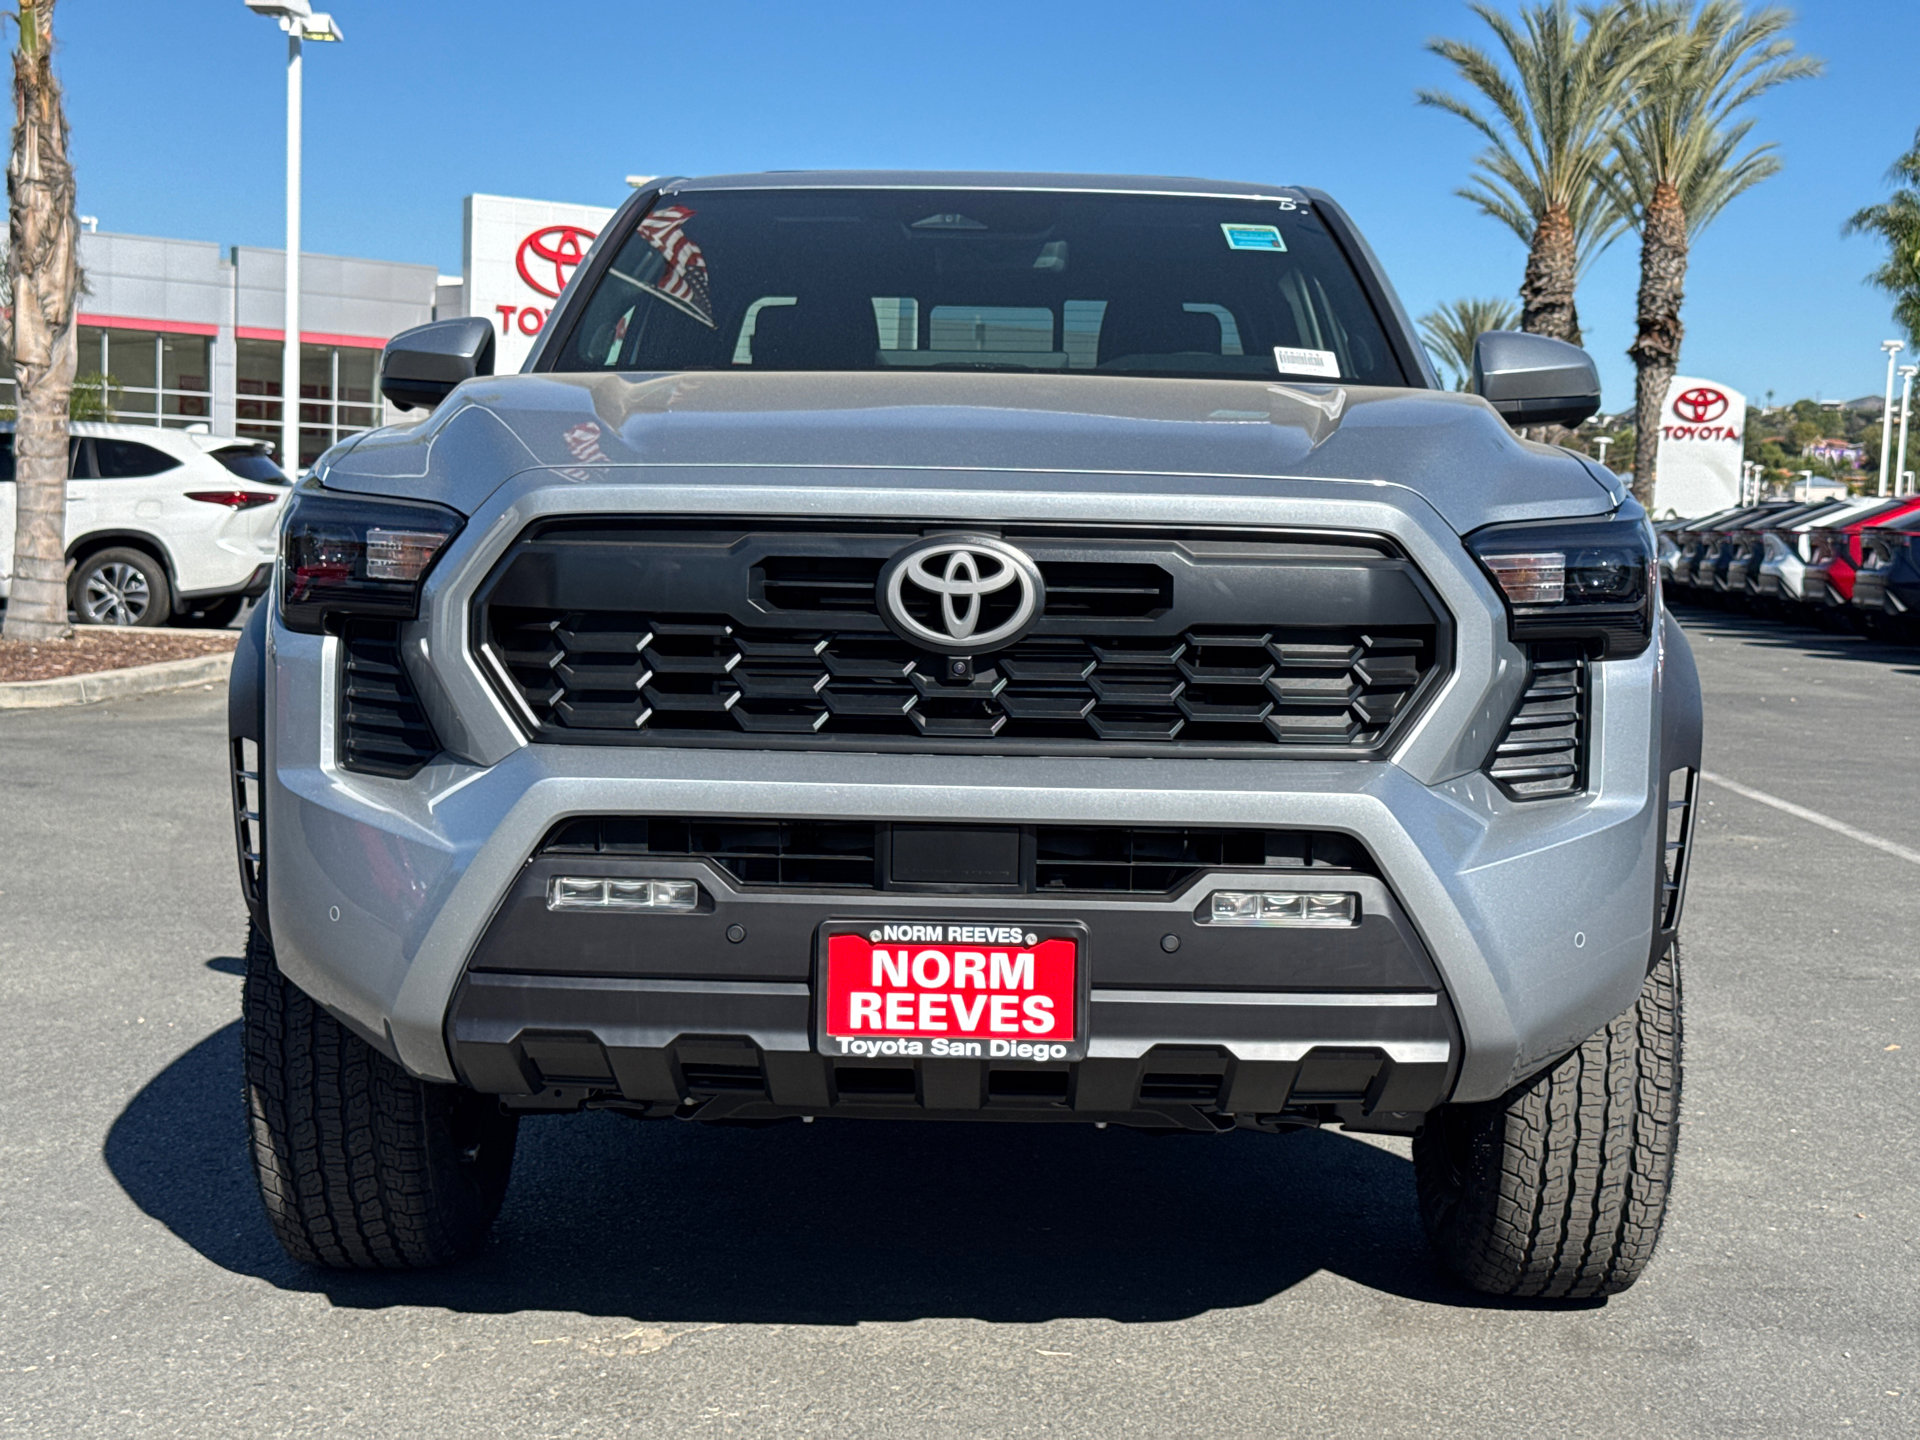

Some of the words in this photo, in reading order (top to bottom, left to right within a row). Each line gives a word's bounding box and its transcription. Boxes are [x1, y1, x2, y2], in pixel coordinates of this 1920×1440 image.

[495, 304, 553, 336] TO
[1662, 426, 1737, 440] TOYOTA
[883, 925, 941, 941] NORM
[948, 927, 1022, 943] REEVES
[871, 950, 1035, 990] NORM
[849, 992, 1055, 1033] REEVES
[835, 1037, 923, 1058] Toyota
[930, 1038, 981, 1056] San
[990, 1040, 1067, 1062] Diego
